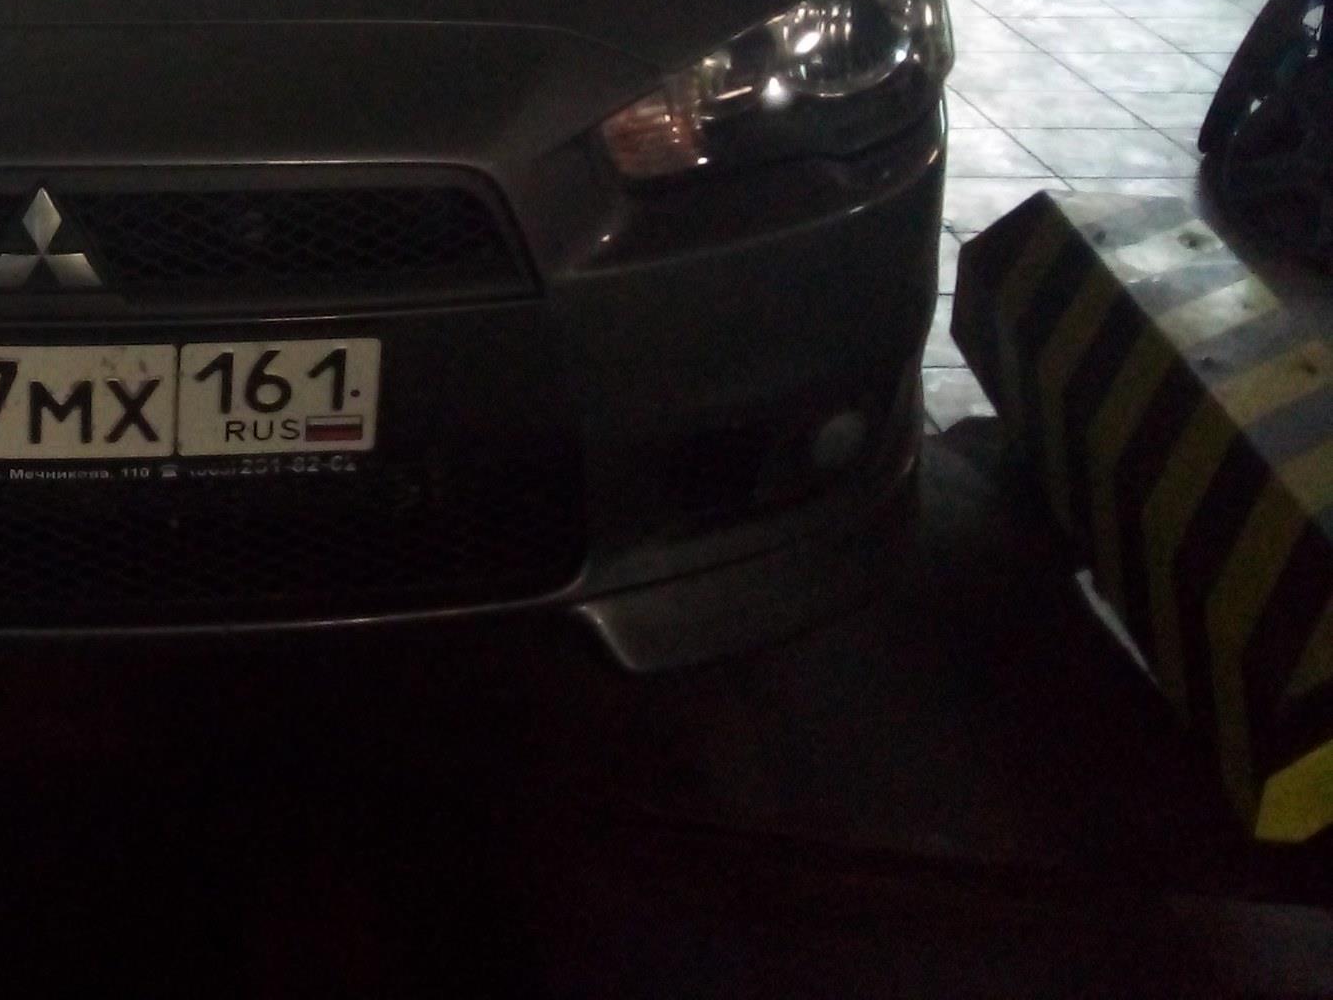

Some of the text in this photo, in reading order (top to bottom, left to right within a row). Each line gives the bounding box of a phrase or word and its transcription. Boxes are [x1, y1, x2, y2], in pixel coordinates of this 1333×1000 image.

[193, 349, 349, 415] 161
[224, 420, 302, 443] RUS
[121, 467, 150, 478] 110
